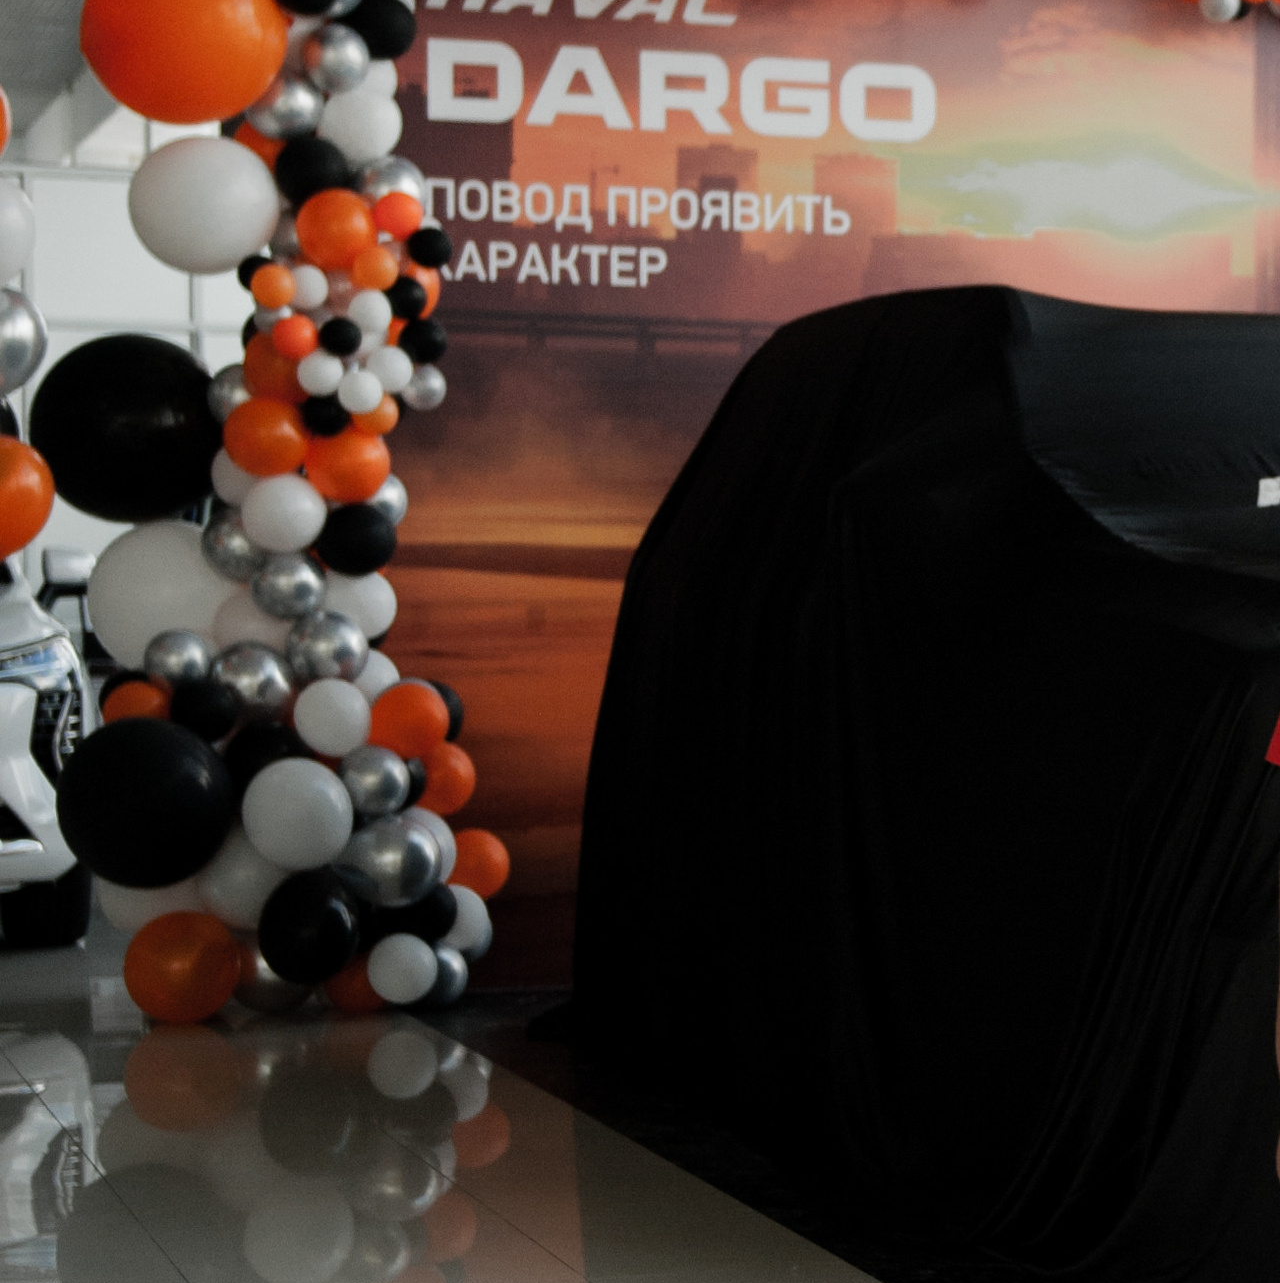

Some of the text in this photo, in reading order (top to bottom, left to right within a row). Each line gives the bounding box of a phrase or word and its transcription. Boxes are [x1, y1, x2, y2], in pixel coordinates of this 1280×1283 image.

[427, 37, 937, 144] DARGO
[427, 178, 851, 236] ПОВОД ПРОЯВИТЬ
